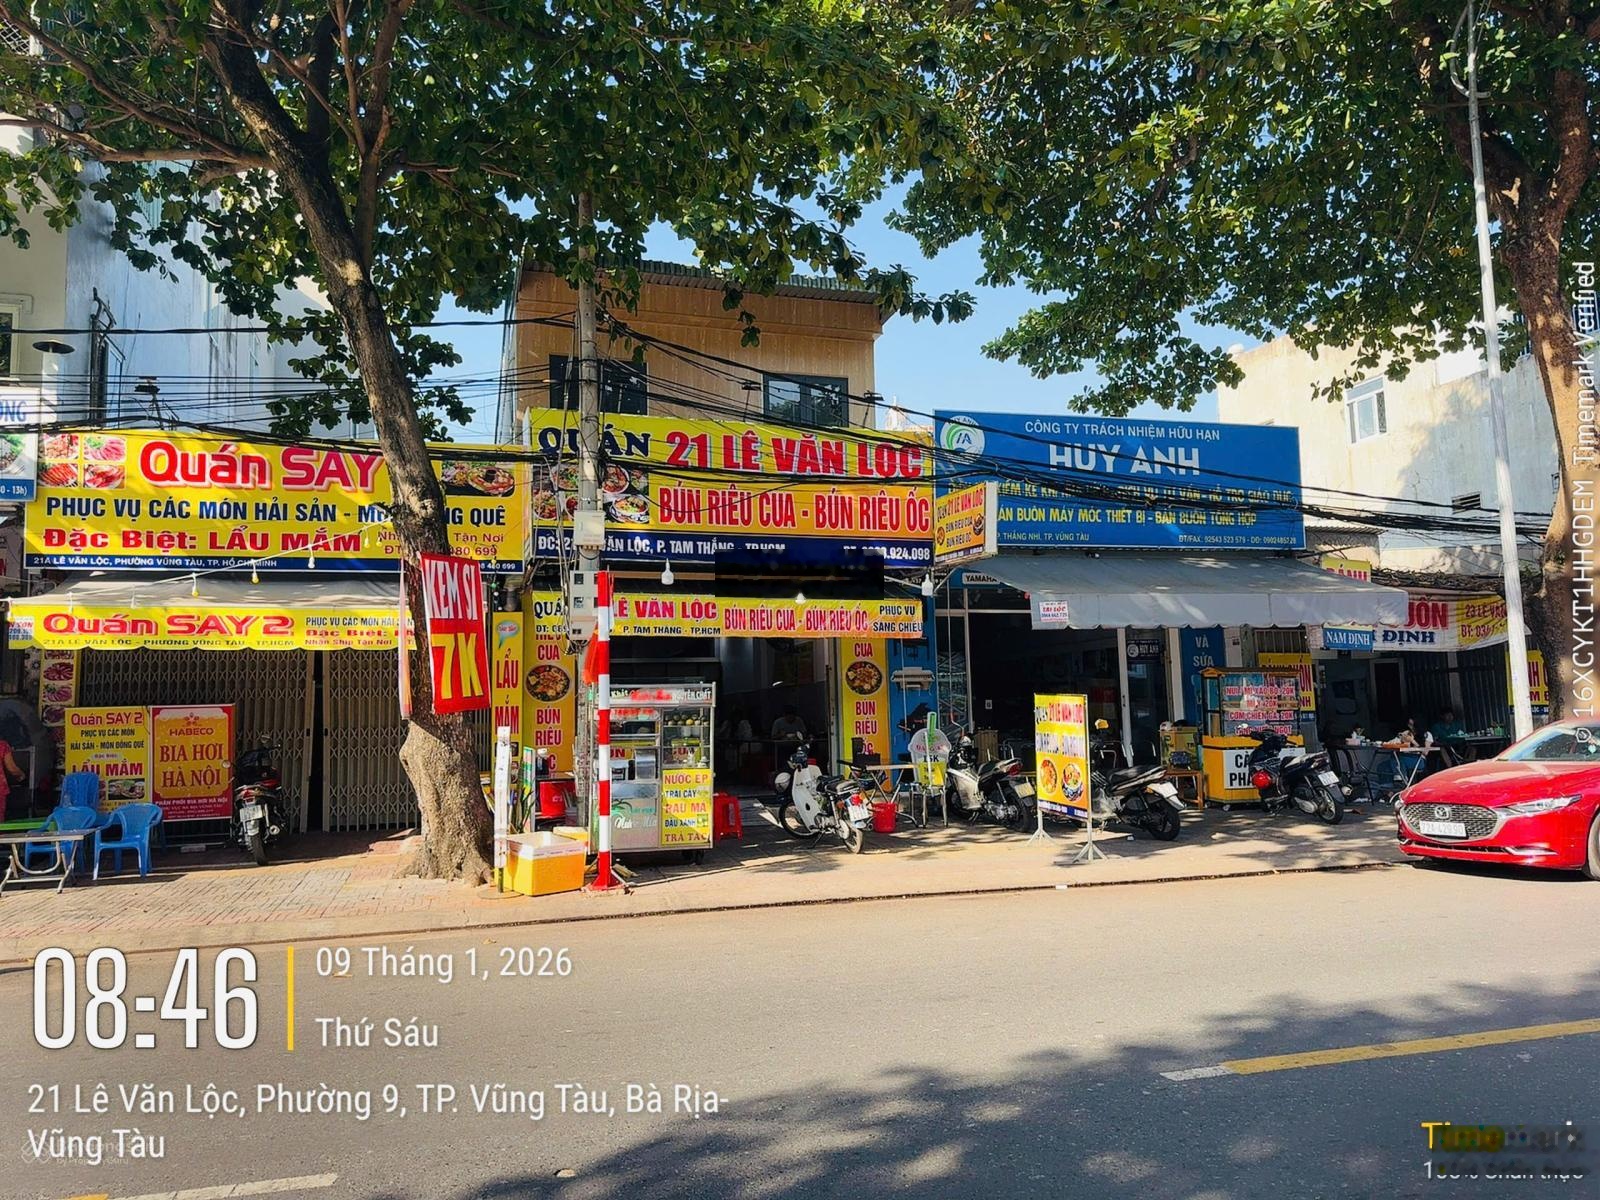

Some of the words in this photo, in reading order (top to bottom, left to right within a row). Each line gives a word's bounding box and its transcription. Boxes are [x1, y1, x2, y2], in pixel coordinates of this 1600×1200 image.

[1025, 419, 1060, 434] CÔNG
[1064, 423, 1079, 434] TY
[1083, 422, 1125, 436] TRÁCH
[1127, 424, 1165, 438] NHIỆM
[1169, 426, 1193, 440] HỮU
[1196, 430, 1220, 442] HẠN
[666, 431, 712, 469] 21
[723, 430, 763, 471] LÊ
[771, 433, 847, 475] VĂN
[1049, 443, 1121, 474] HUY
[1130, 446, 1200, 476] ANH
[140, 440, 272, 489] Quán
[281, 446, 385, 492] SAY
[46, 496, 106, 522] PHỤC
[114, 498, 141, 522] VỤ
[149, 496, 191, 519] CÁC
[199, 495, 247, 520] MÓN
[254, 497, 288, 521] HẢI
[295, 497, 336, 522] SẢN
[470, 504, 506, 526] QUÊ
[659, 480, 701, 524] BÚN
[707, 483, 752, 527] RIÊU
[758, 491, 797, 528] CUA
[814, 488, 854, 529] BÚN
[859, 490, 901, 531] RIÊU
[906, 486, 931, 533] ỐC
[1016, 504, 1046, 522] BUÔN
[1050, 503, 1074, 523] MÁY
[1078, 503, 1102, 523] MÓC
[1105, 504, 1132, 524] THIẾT
[1136, 509, 1146, 527] BỊ
[43, 527, 109, 552] Đặc
[122, 528, 197, 554] Biệt:
[208, 525, 269, 550] LẨU
[281, 527, 361, 552] MẮM
[453, 532, 477, 545] Tận
[482, 532, 504, 543] Nơi
[627, 536, 654, 555] LỘC,
[657, 542, 667, 554] P.
[669, 541, 694, 555] TAM
[1055, 531, 1074, 542] VŨNG
[1077, 532, 1090, 542] TÀU
[475, 545, 498, 556] 699
[33, 557, 51, 565] 21A
[53, 554, 66, 565] LÊ
[67, 556, 88, 566] VĂN
[90, 555, 113, 568] LỘC,
[114, 555, 153, 567] PHƯỜNG
[156, 555, 183, 567] VŨNG
[185, 556, 205, 568] TÀU,
[423, 560, 463, 619] KEM
[635, 598, 674, 618] VĂN
[681, 599, 717, 622] LỘC
[724, 604, 746, 630] BÚN
[749, 604, 773, 631] RIÊU
[776, 608, 796, 631] CUA
[805, 605, 826, 631] BÚN
[829, 605, 852, 632] RIÊU
[854, 603, 868, 632] ỐC
[879, 605, 903, 617] PHỤC
[905, 605, 916, 618] VỤ
[43, 613, 158, 636] Quán
[166, 614, 260, 636] SAY
[262, 614, 295, 636] 2
[306, 616, 328, 629] PHỤC
[329, 616, 341, 629] VỤ
[342, 616, 359, 626] CÁC
[360, 616, 379, 627] MÓN
[306, 629, 340, 637] Đặc
[1195, 633, 1209, 648] VÀ
[1326, 631, 1346, 643] NAM
[1348, 632, 1370, 647] ĐỊNH
[1383, 629, 1435, 646] ĐỊNH
[332, 639, 354, 647] Ship
[854, 643, 873, 657] CUA
[537, 644, 561, 661] CUA
[431, 632, 483, 700] 7K
[495, 648, 520, 689] LẨU
[536, 704, 561, 725] BÚN
[856, 699, 876, 716] BÚN
[71, 711, 103, 726] Quán
[106, 712, 131, 725] SAY
[134, 711, 143, 724] 2
[856, 717, 878, 735] RIÊU
[81, 729, 97, 738] PHỤC
[107, 728, 120, 737] CÁC
[169, 727, 215, 736] HABECO
[535, 728, 562, 746] RIÊU
[160, 744, 186, 763] BIA
[192, 742, 224, 761] HƠI
[105, 757, 143, 777] MẮM
[161, 766, 186, 788] HÀ
[190, 764, 221, 790] NỘI
